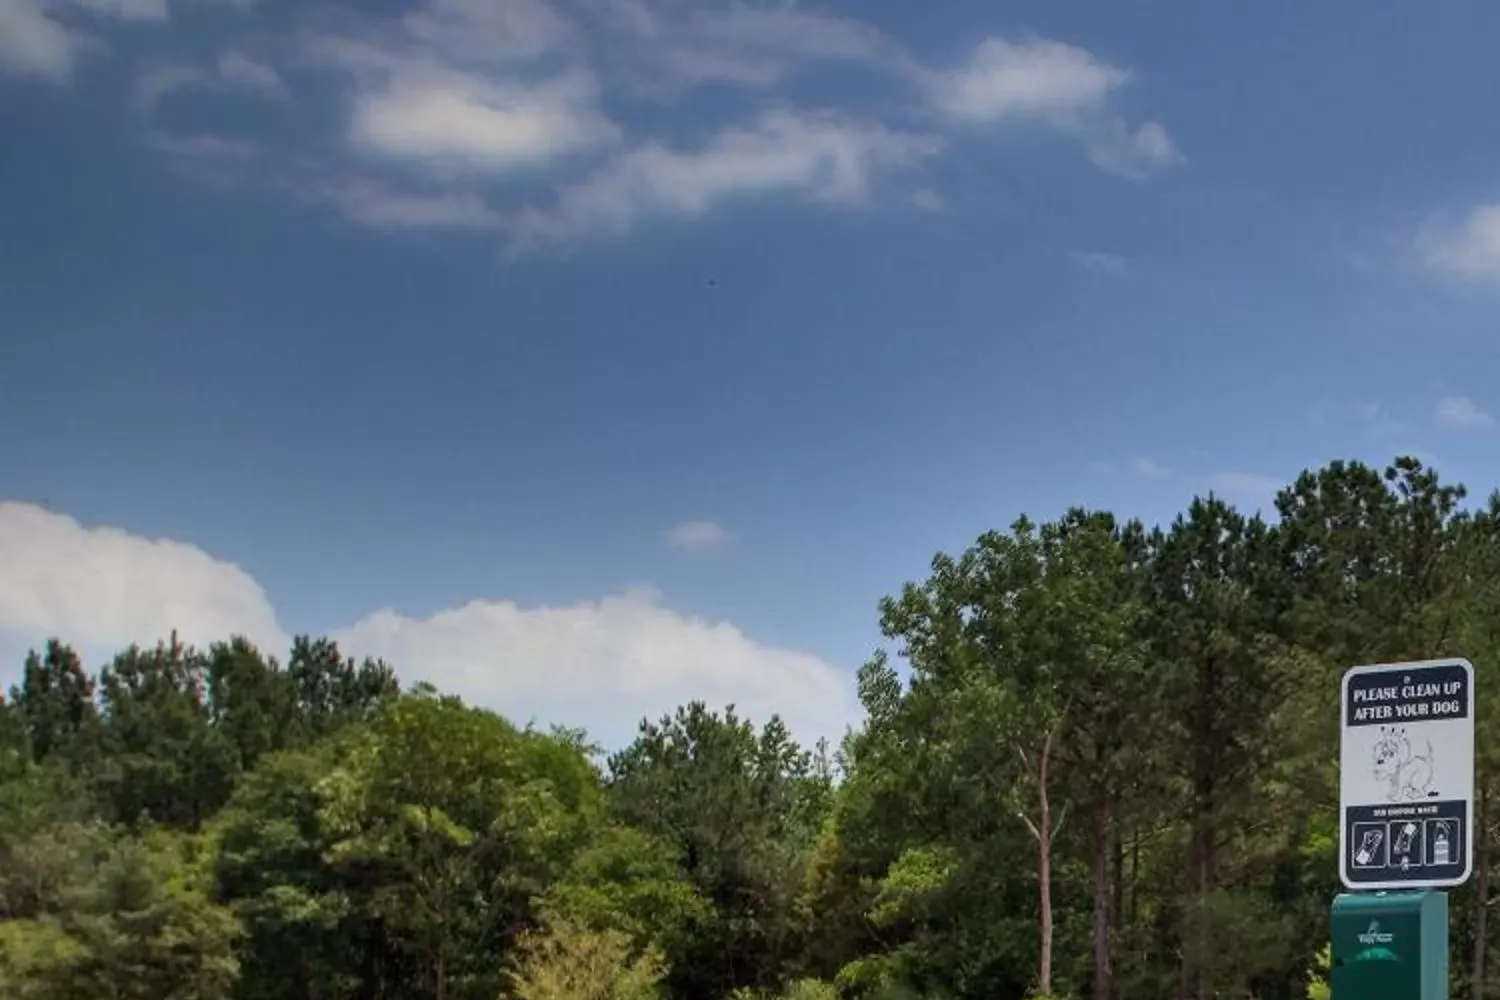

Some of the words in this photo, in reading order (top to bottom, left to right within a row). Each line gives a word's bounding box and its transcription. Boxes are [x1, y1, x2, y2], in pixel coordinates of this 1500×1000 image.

[1353, 687, 1398, 702] PLEASE
[1402, 683, 1441, 698] CLEAN
[1444, 681, 1461, 695] UP
[1354, 706, 1393, 720] AFTER
[1395, 703, 1429, 717] YOUR
[1432, 700, 1460, 714] DOG
